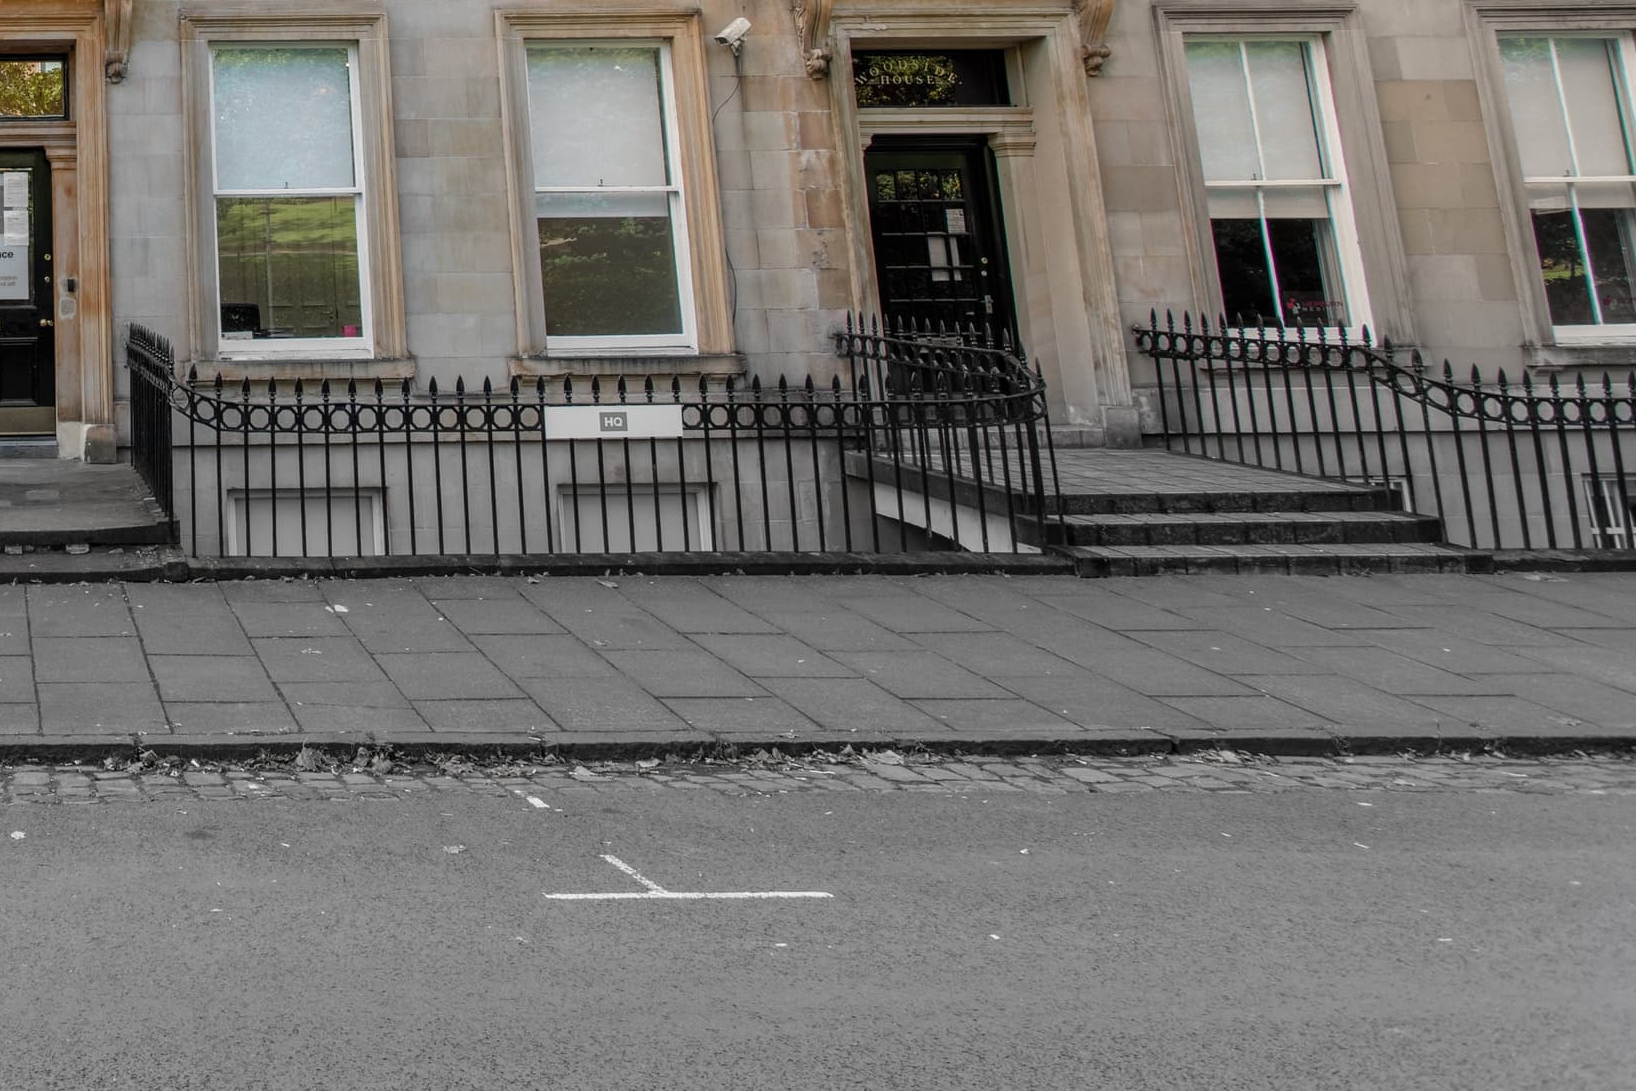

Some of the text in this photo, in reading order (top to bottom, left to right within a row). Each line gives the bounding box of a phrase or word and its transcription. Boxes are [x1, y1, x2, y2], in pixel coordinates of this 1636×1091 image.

[854, 58, 958, 85] WOODSIDE
[880, 75, 935, 85] HOUSE
[603, 416, 624, 428] HQ
